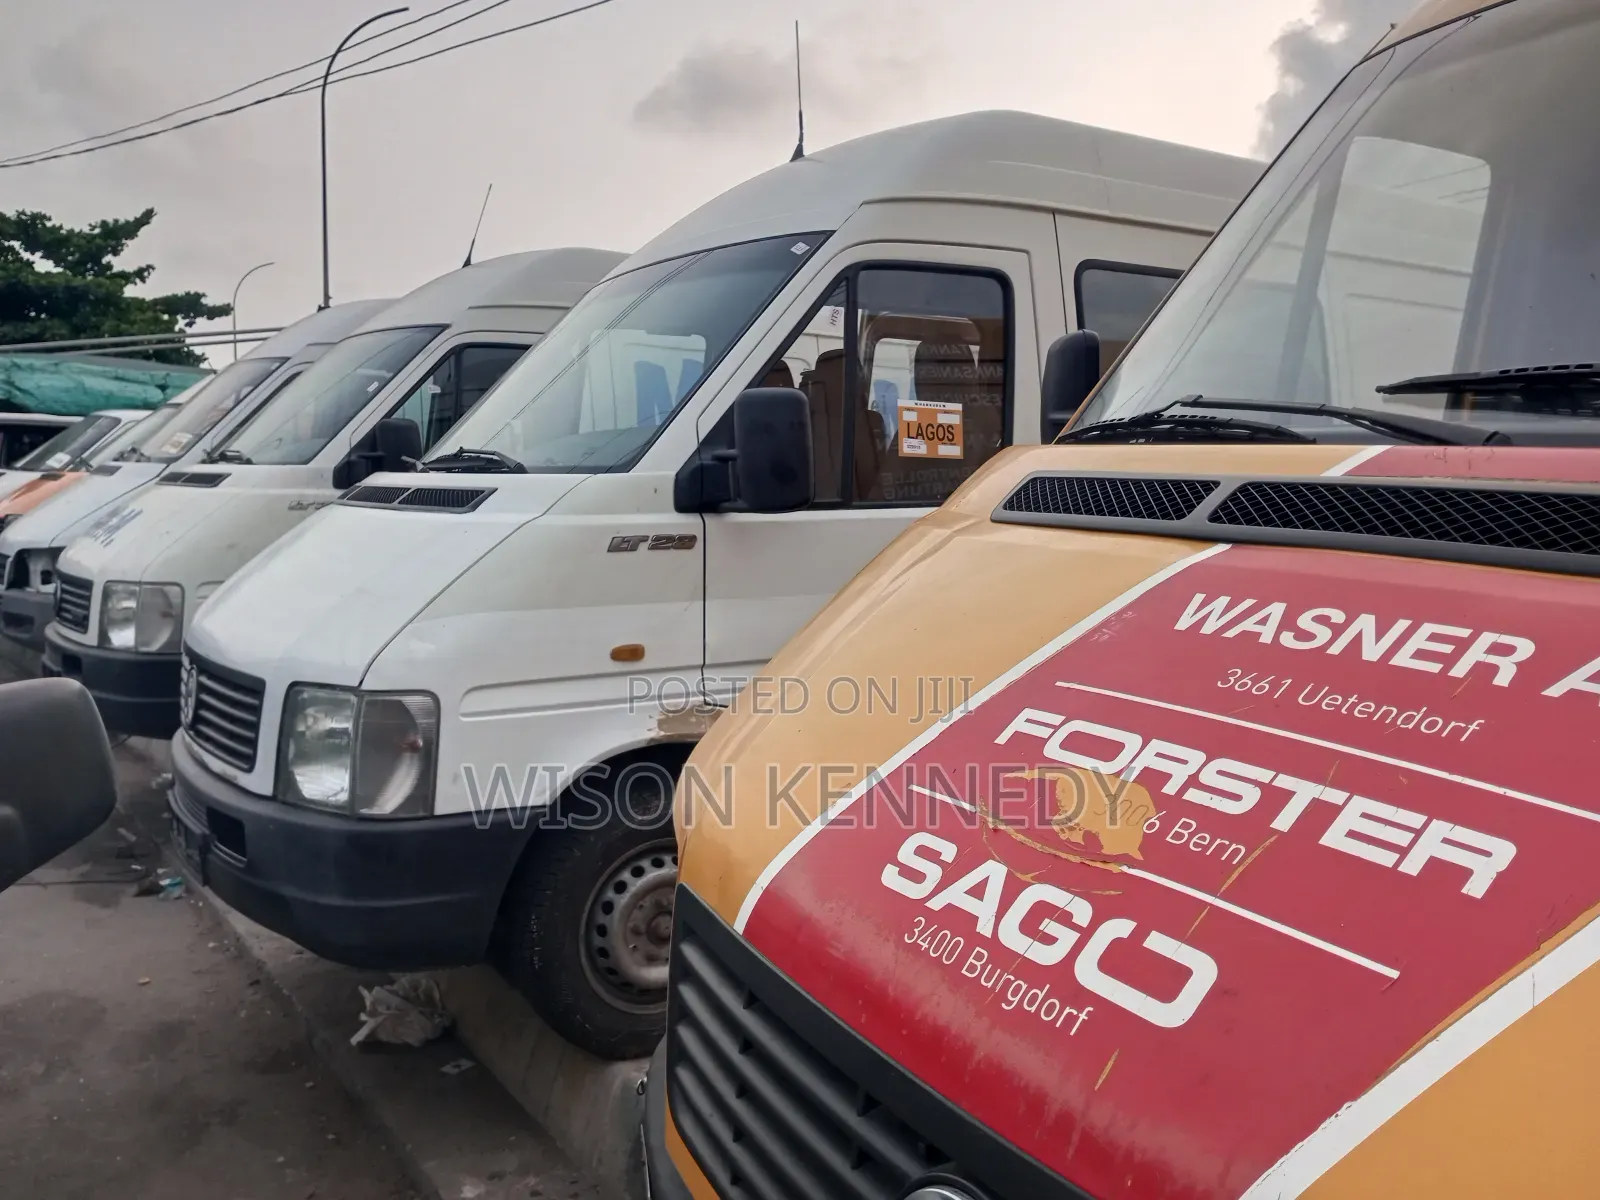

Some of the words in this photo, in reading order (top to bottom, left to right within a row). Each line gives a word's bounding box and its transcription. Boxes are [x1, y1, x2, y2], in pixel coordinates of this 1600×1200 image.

[906, 422, 955, 442] LAGOS
[607, 535, 650, 553] LT
[648, 534, 698, 550] 28
[1174, 592, 1536, 688] WASNER
[1217, 668, 1293, 699] 3661
[1297, 683, 1487, 742] Uetendorf
[994, 706, 1518, 899] FORSTER
[1165, 816, 1246, 867] Bern
[880, 831, 1219, 1028] SAGO
[904, 916, 965, 966] 3400
[961, 946, 1094, 1036] Burgdorf
